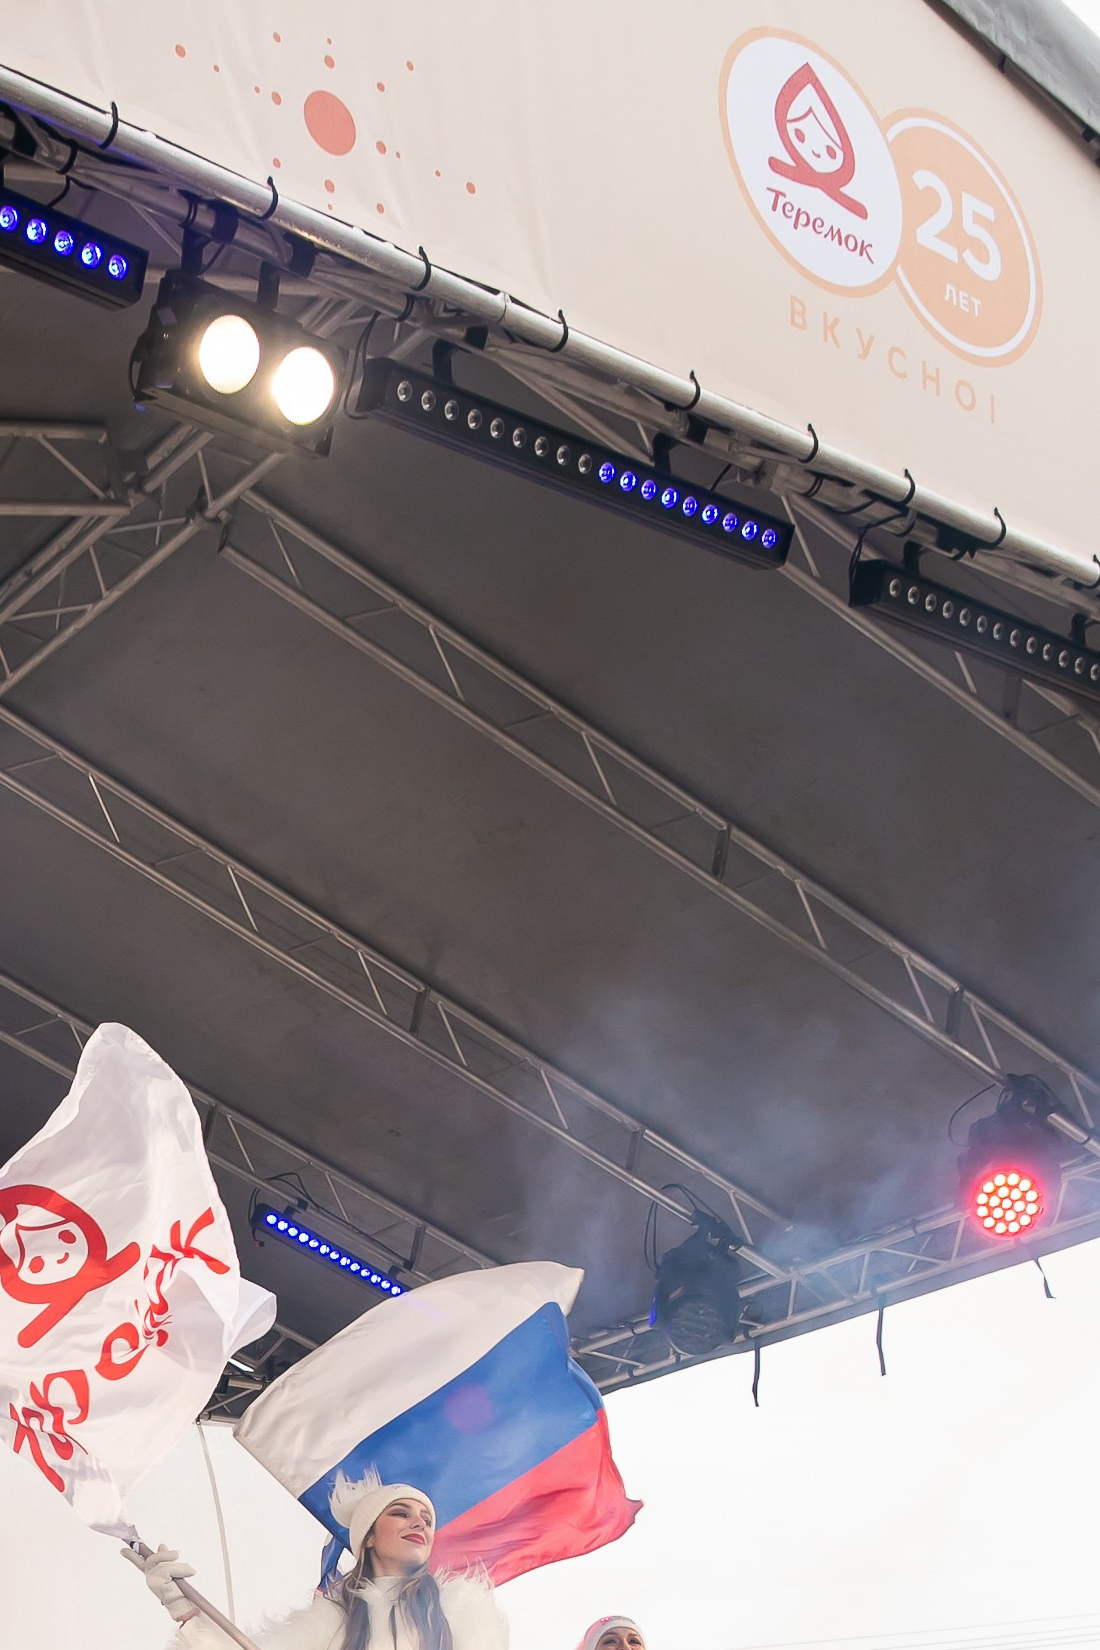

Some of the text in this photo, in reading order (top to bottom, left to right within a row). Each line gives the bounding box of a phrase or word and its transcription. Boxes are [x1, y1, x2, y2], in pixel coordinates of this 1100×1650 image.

[766, 187, 875, 265] Теремок
[912, 169, 1002, 282] 25
[944, 283, 982, 318] ЛЕТ
